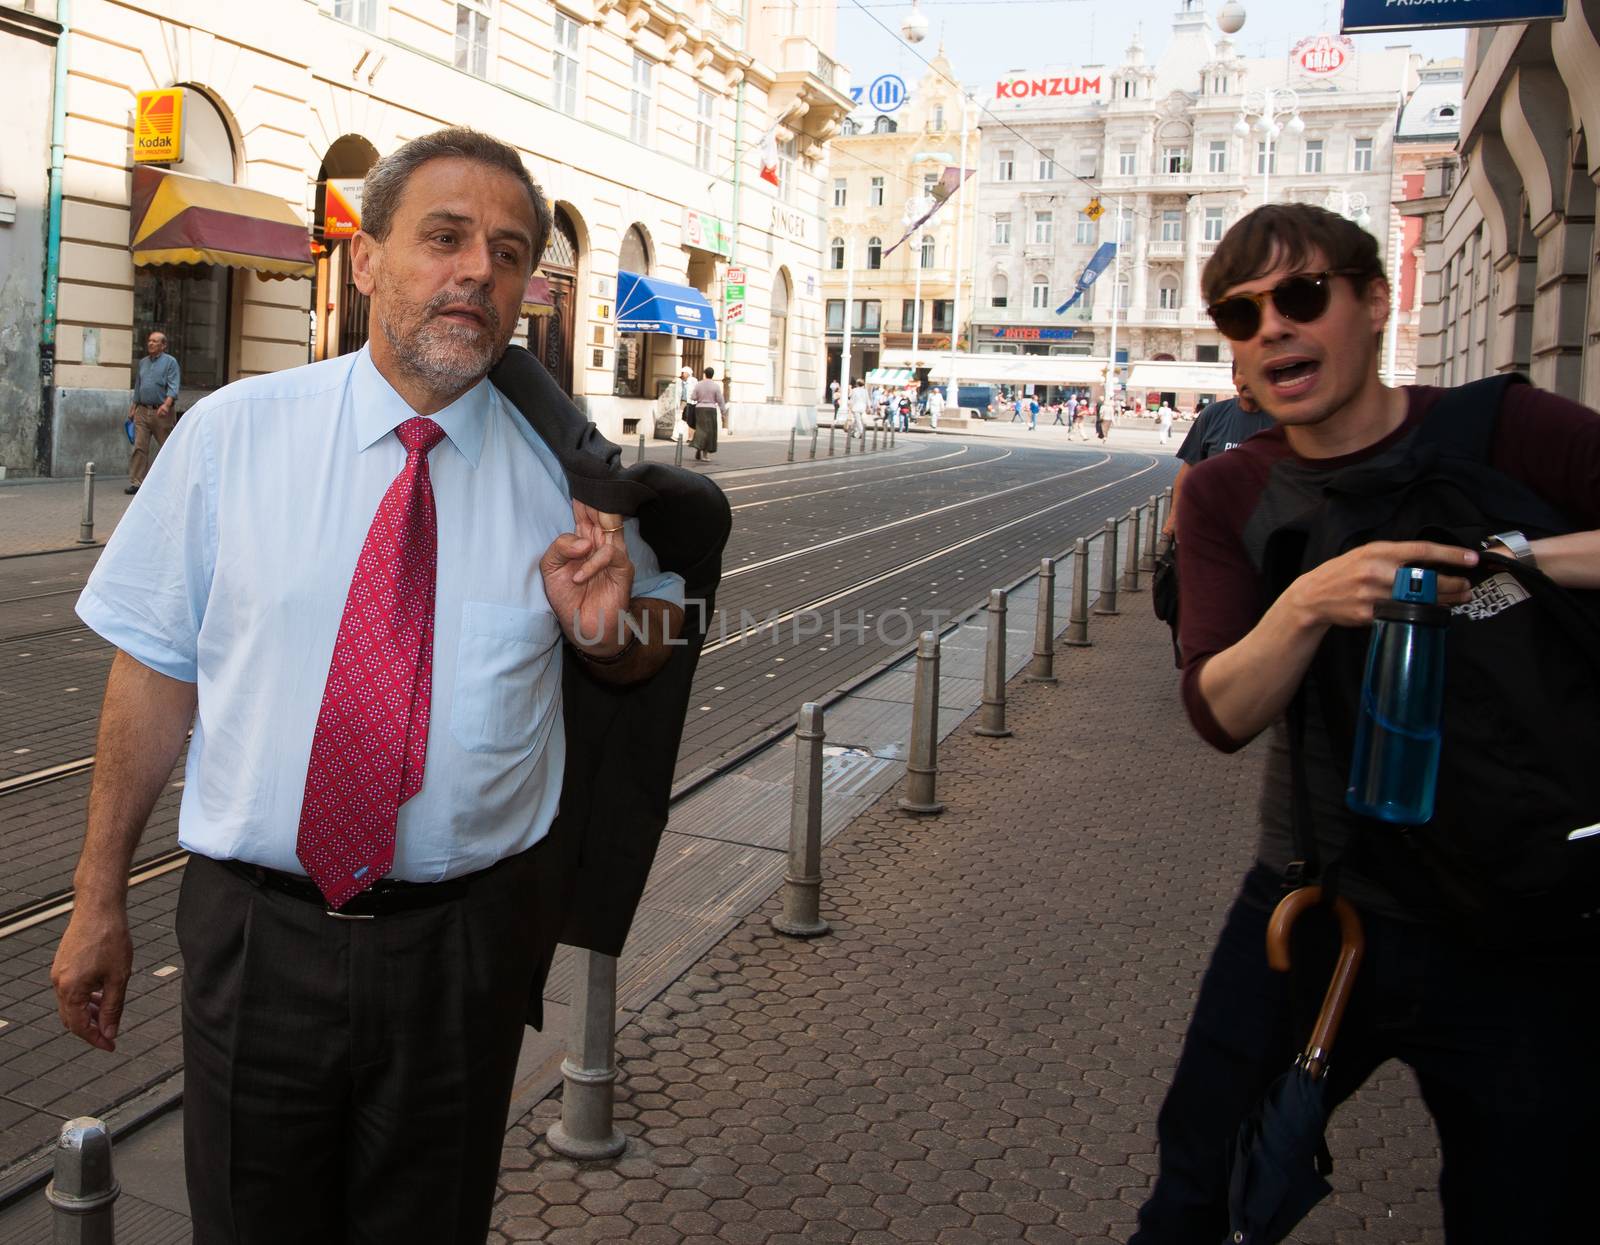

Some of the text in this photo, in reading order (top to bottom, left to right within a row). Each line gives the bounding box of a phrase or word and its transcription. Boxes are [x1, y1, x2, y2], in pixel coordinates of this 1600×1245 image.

[996, 76, 1101, 99] KONZUM
[139, 136, 172, 148] Kodak
[771, 205, 806, 238] SINGER
[1471, 578, 1498, 600] THE
[1451, 587, 1505, 616] NORTH
[1469, 598, 1511, 620] FACE
